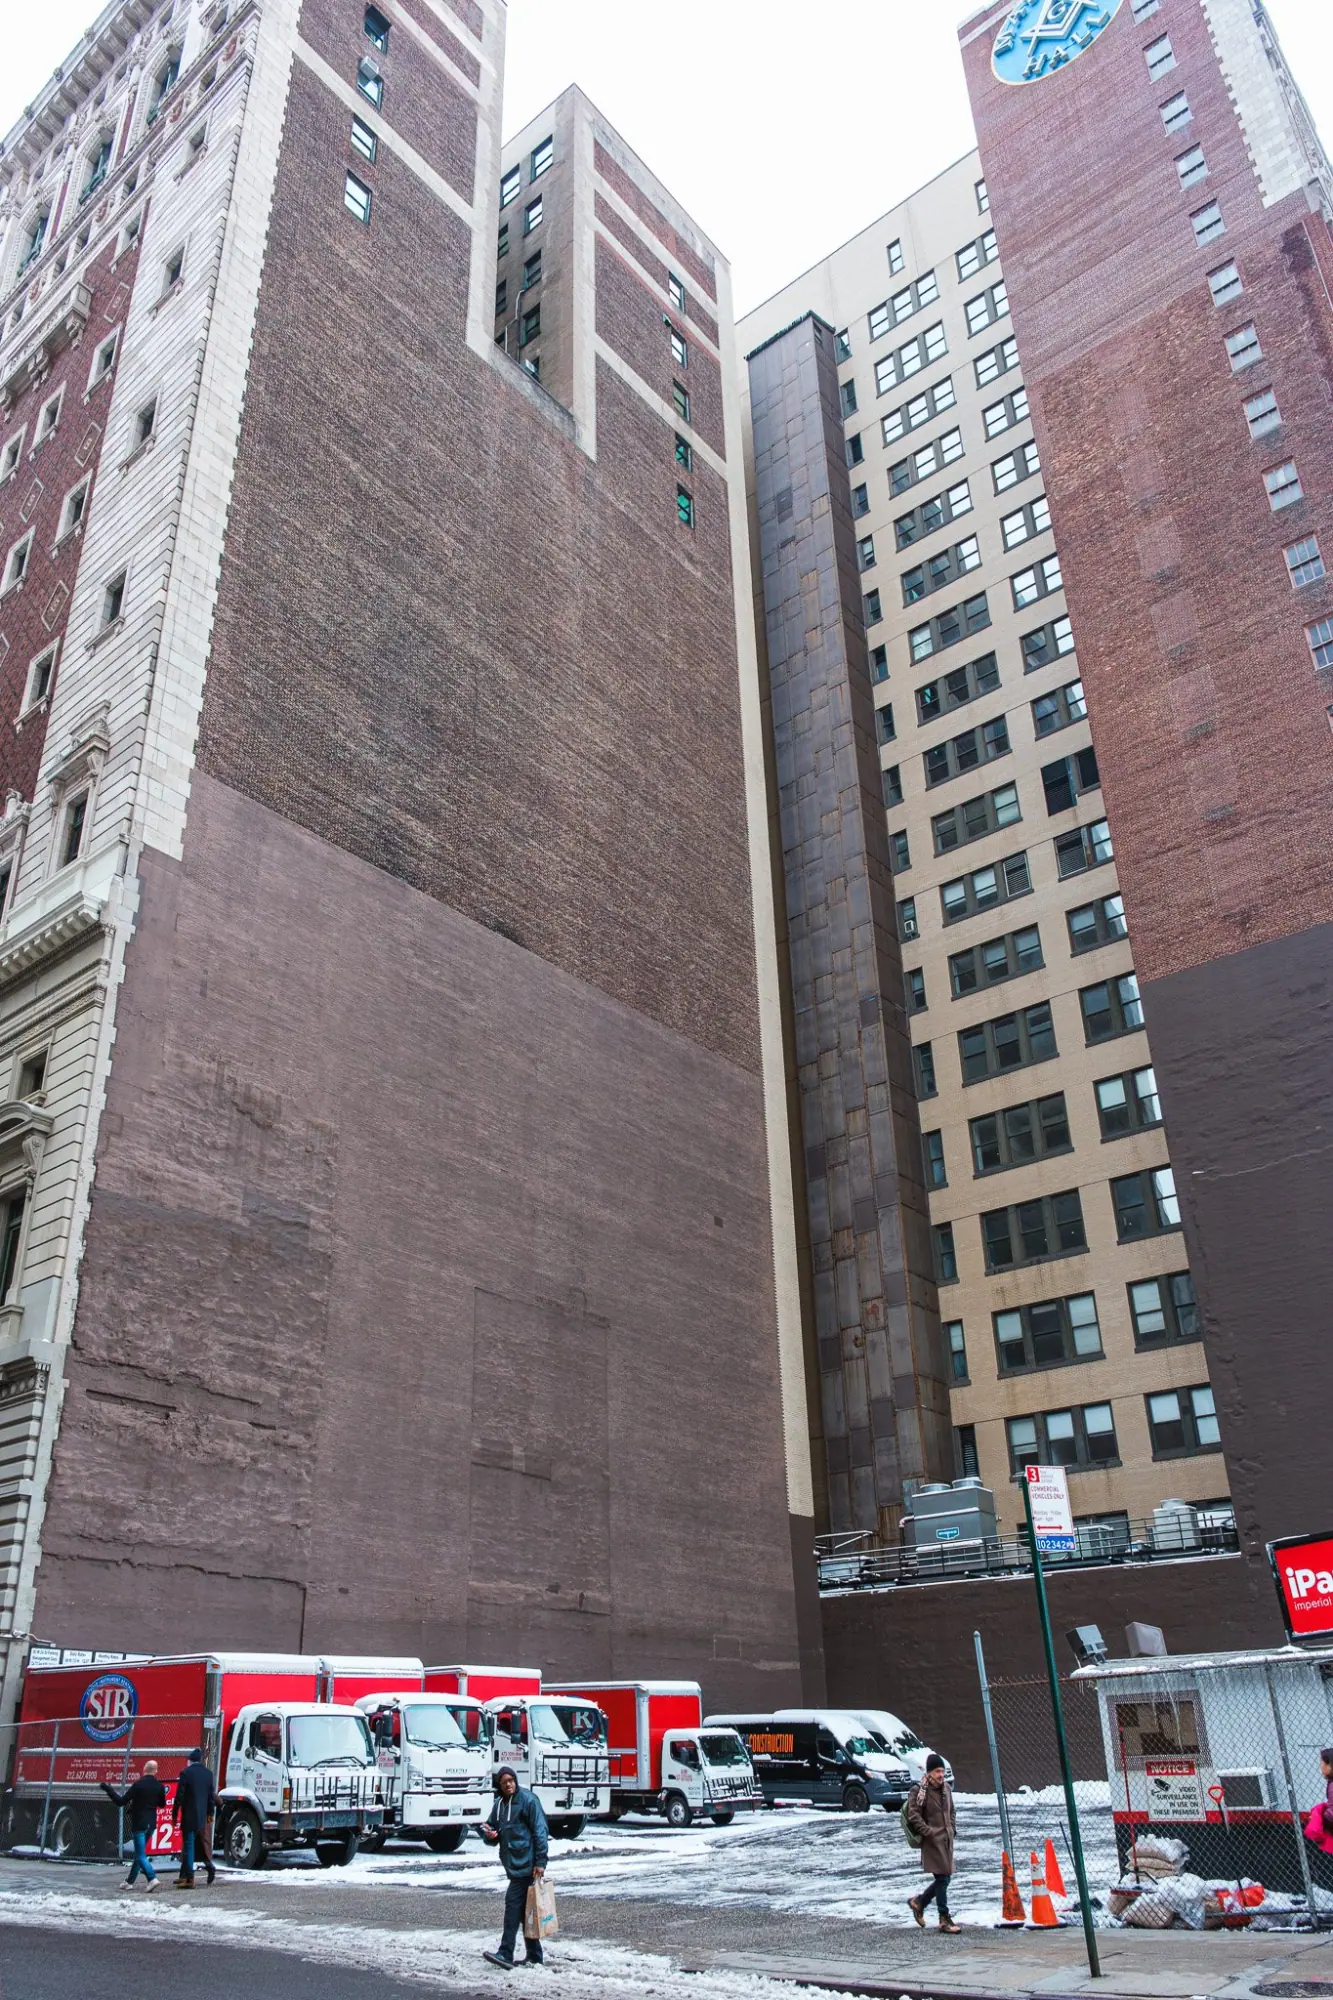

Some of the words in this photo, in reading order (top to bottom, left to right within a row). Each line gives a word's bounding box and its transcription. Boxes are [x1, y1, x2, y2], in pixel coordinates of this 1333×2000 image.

[1022, 9, 1111, 79] HALL
[1030, 1468, 1037, 1482] 3
[1031, 1485, 1060, 1493] COMMERCIAL
[1037, 1539, 1067, 1550] 102342
[1285, 1567, 1333, 1599] iPa
[1294, 1596, 1332, 1611] imperial
[88, 1689, 130, 1719] SIR
[749, 1733, 794, 1753] CONSTRUCTION
[105, 1770, 141, 1781] sir-us.com
[1150, 1764, 1190, 1774] NOTICE
[151, 1822, 173, 1850] 12
